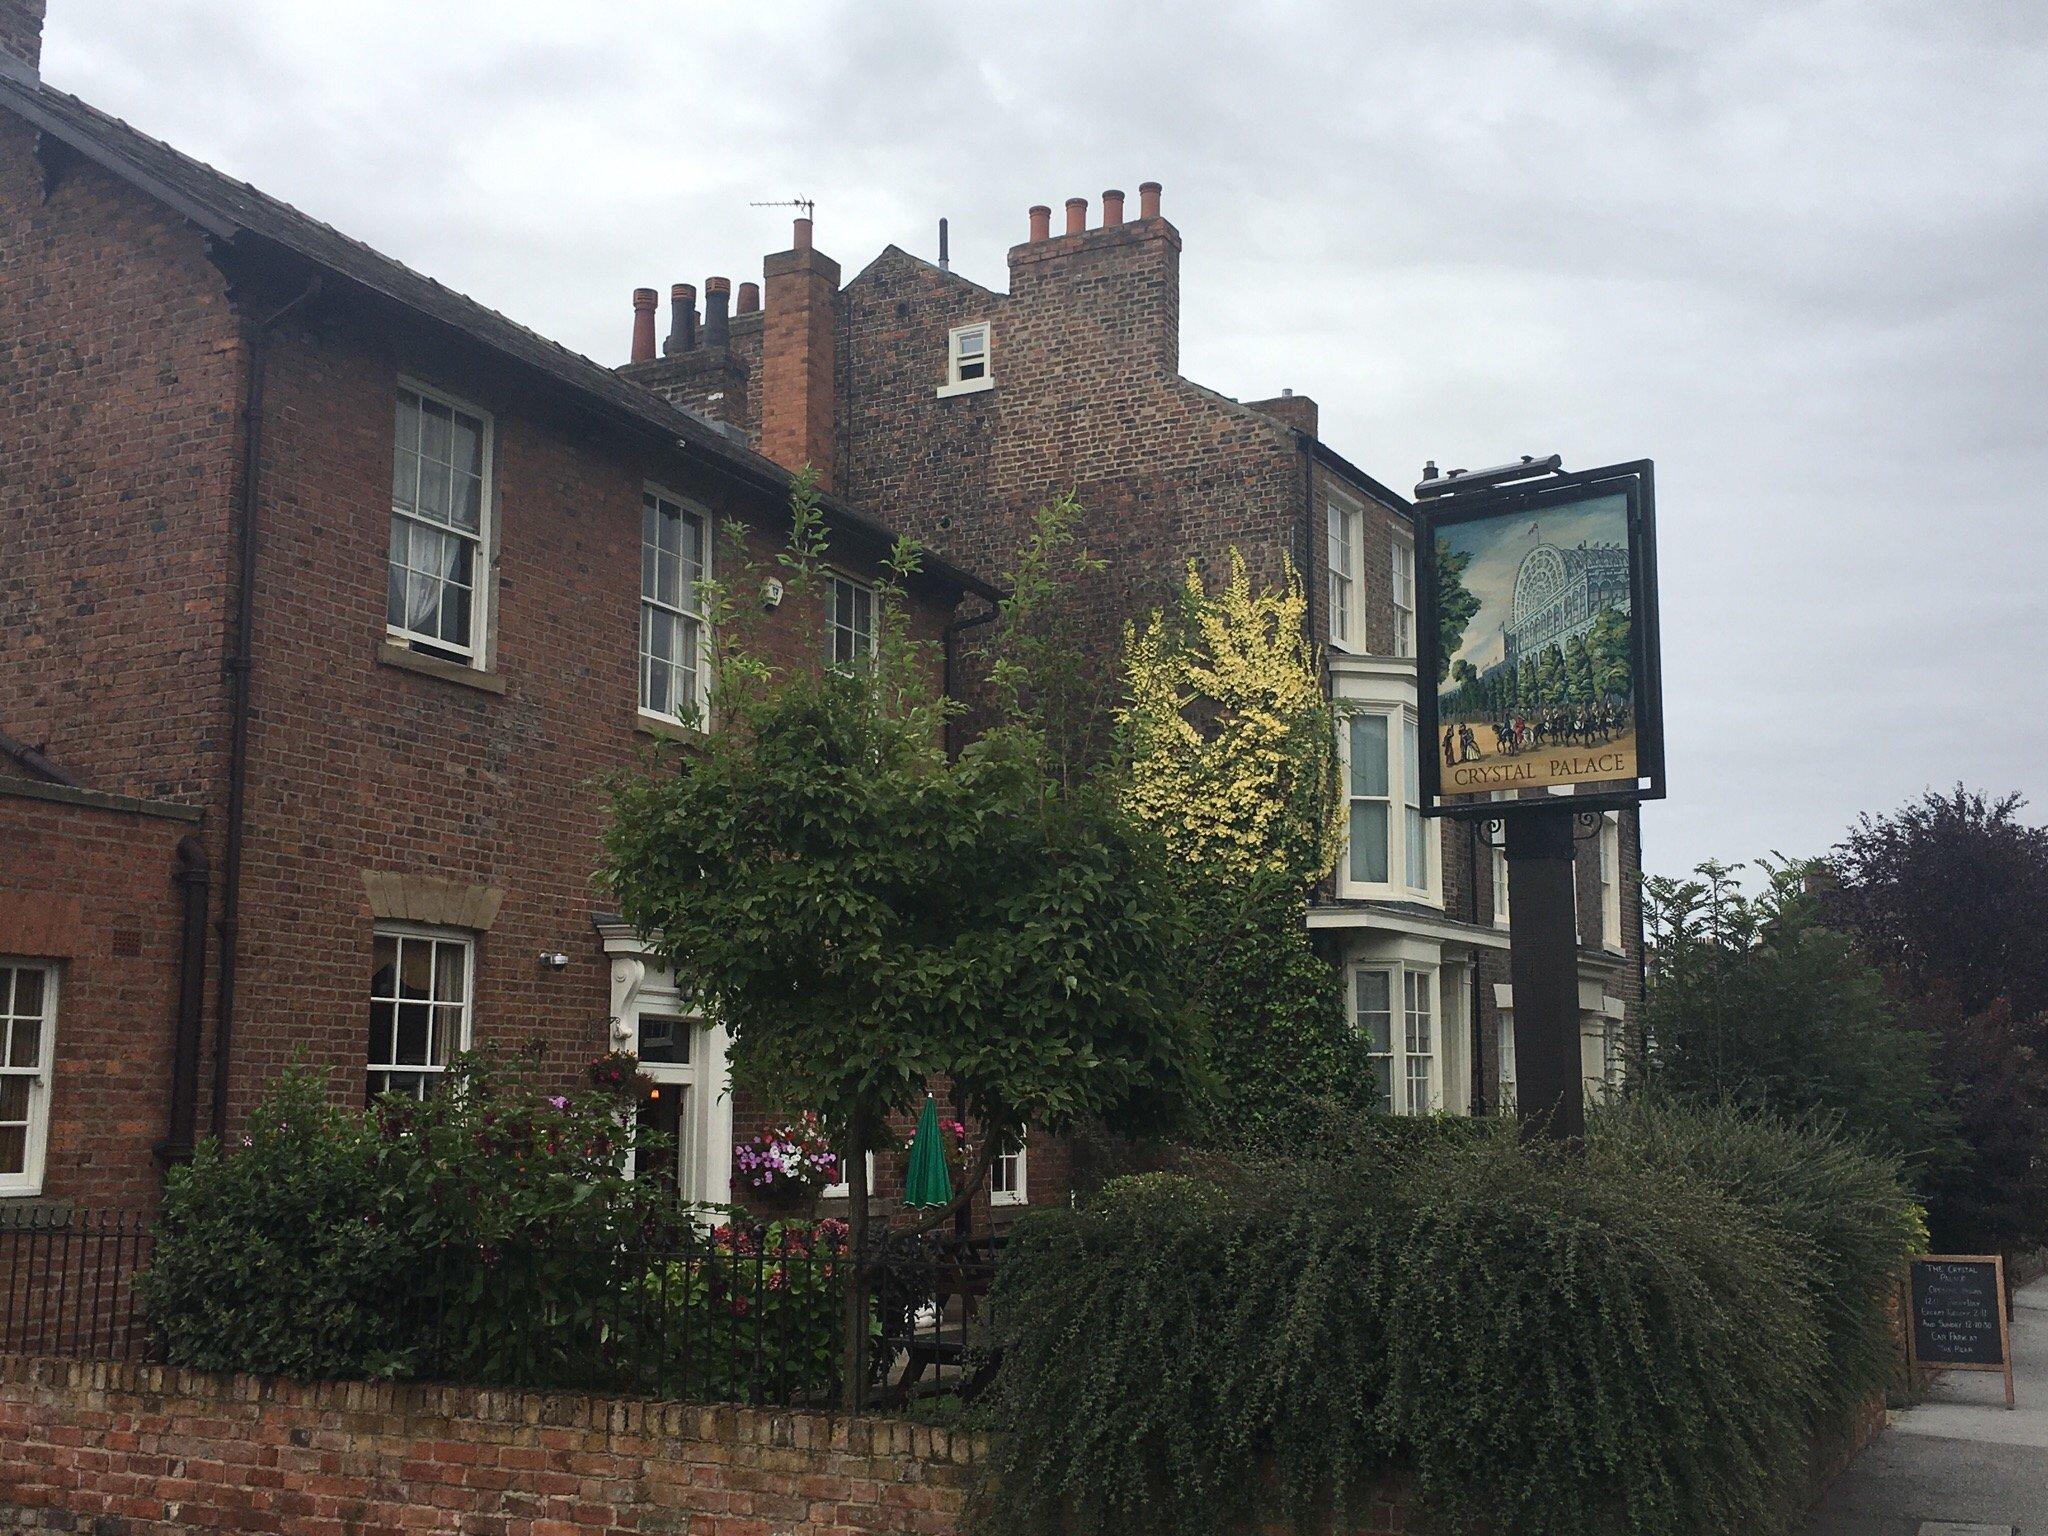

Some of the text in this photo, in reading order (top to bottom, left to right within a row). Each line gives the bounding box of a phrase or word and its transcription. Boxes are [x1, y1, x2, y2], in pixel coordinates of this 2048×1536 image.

[1454, 753, 1626, 786] CRYSTAL PALACE
[1931, 1332, 1947, 1341] CAR
[1949, 1331, 1968, 1341] PARK
